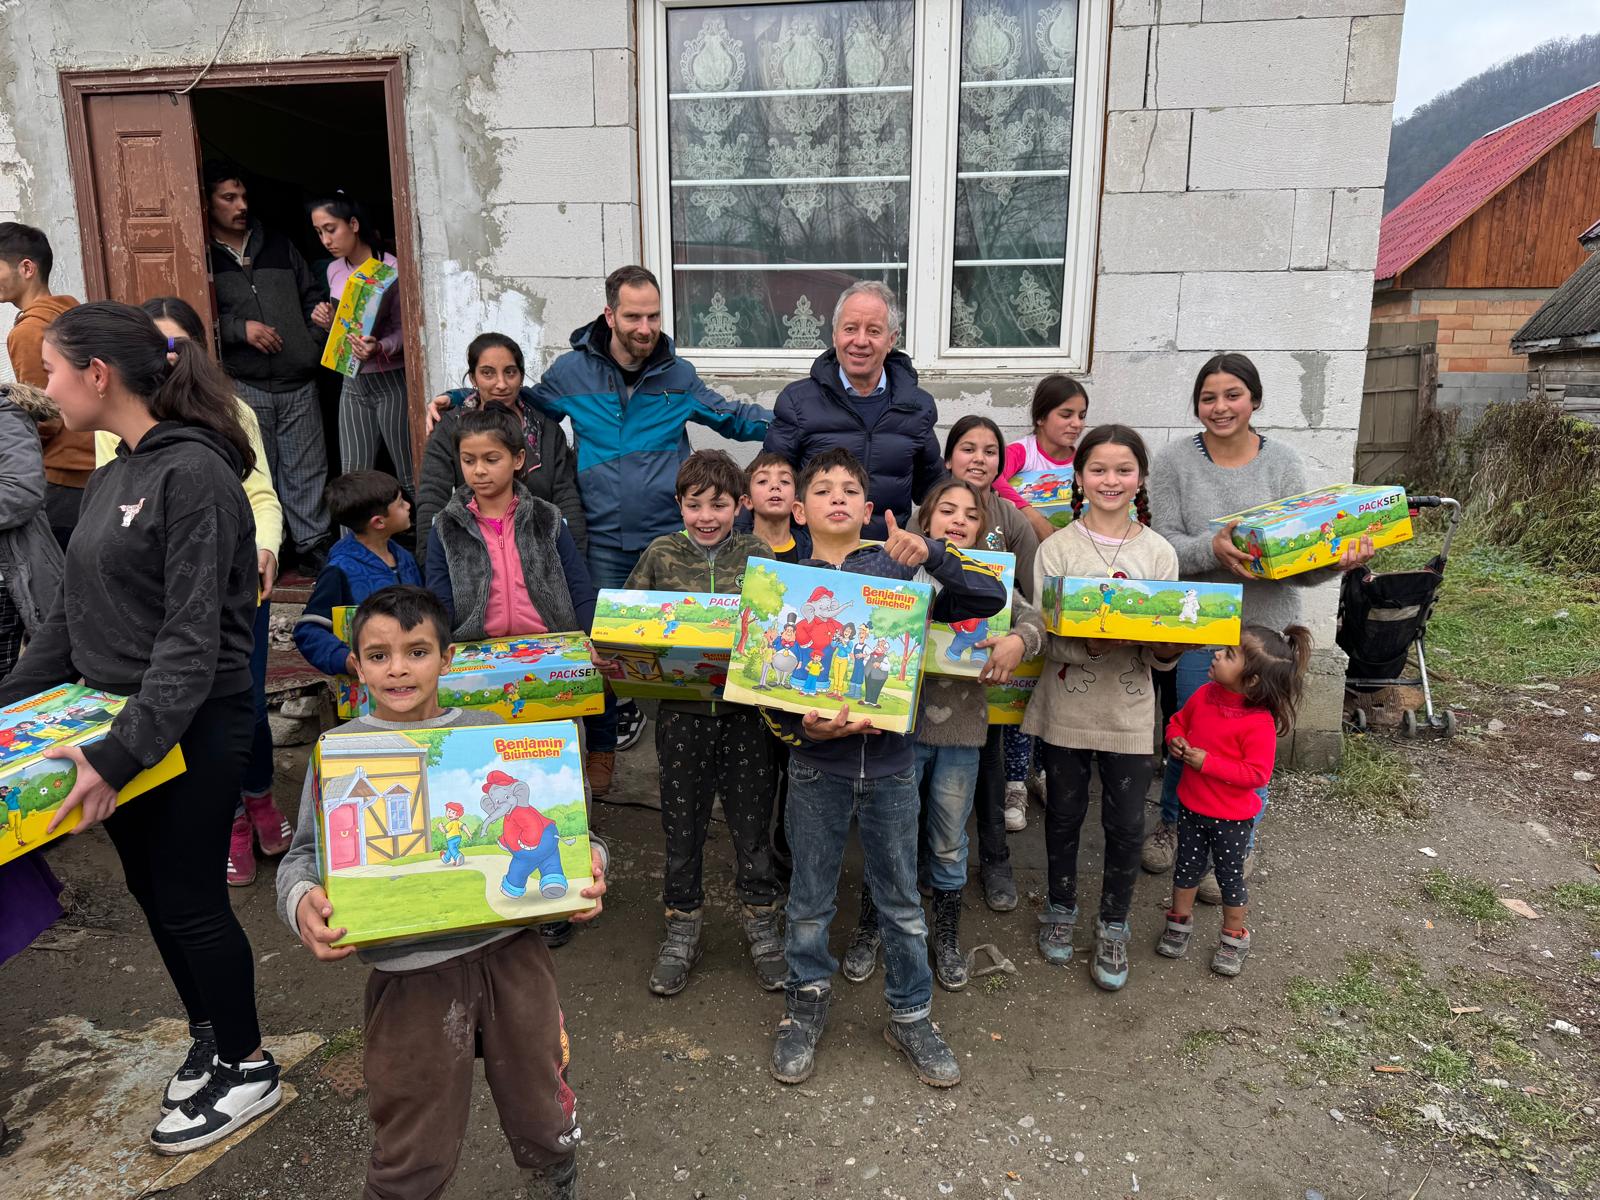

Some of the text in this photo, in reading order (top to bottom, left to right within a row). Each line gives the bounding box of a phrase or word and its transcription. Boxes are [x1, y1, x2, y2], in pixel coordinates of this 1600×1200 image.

[1358, 494, 1401, 513] PACKSET
[709, 597, 739, 607] PACK
[863, 586, 916, 605] Benjamin
[866, 596, 911, 610] Blümchen
[549, 667, 597, 680] PACKSET
[1007, 679, 1038, 688] PACKS
[494, 737, 564, 753] Benjamin
[503, 748, 561, 761] Blümchen
